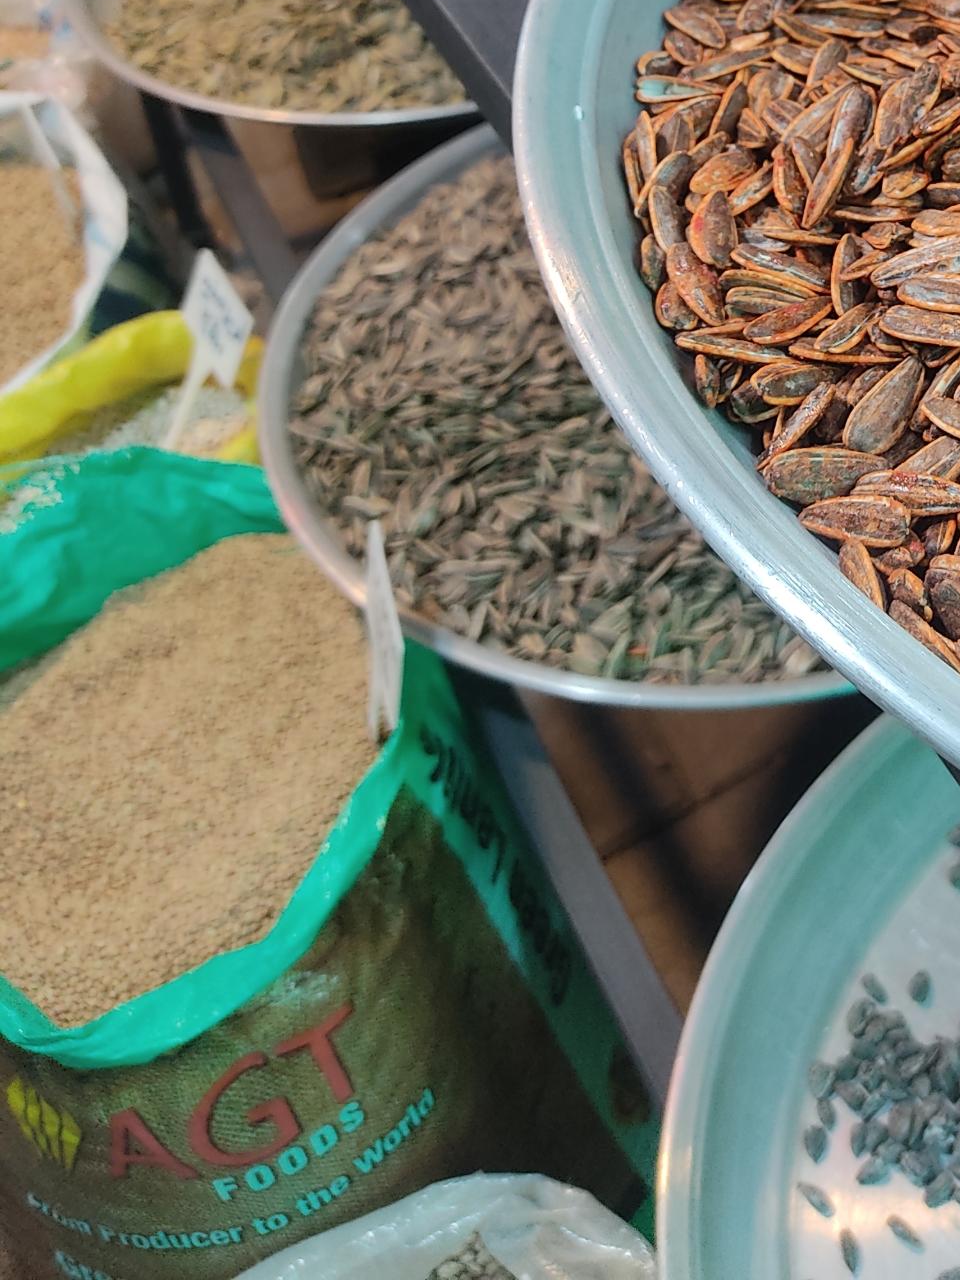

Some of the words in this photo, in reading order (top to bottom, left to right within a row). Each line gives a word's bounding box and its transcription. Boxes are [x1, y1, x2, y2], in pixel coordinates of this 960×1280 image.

[97, 1223, 244, 1250] Producer
[252, 1211, 289, 1235] to
[295, 1174, 352, 1217] the
[352, 1087, 436, 1175] World
[107, 1000, 355, 1180] AGT
[211, 1099, 366, 1202] FOODS
